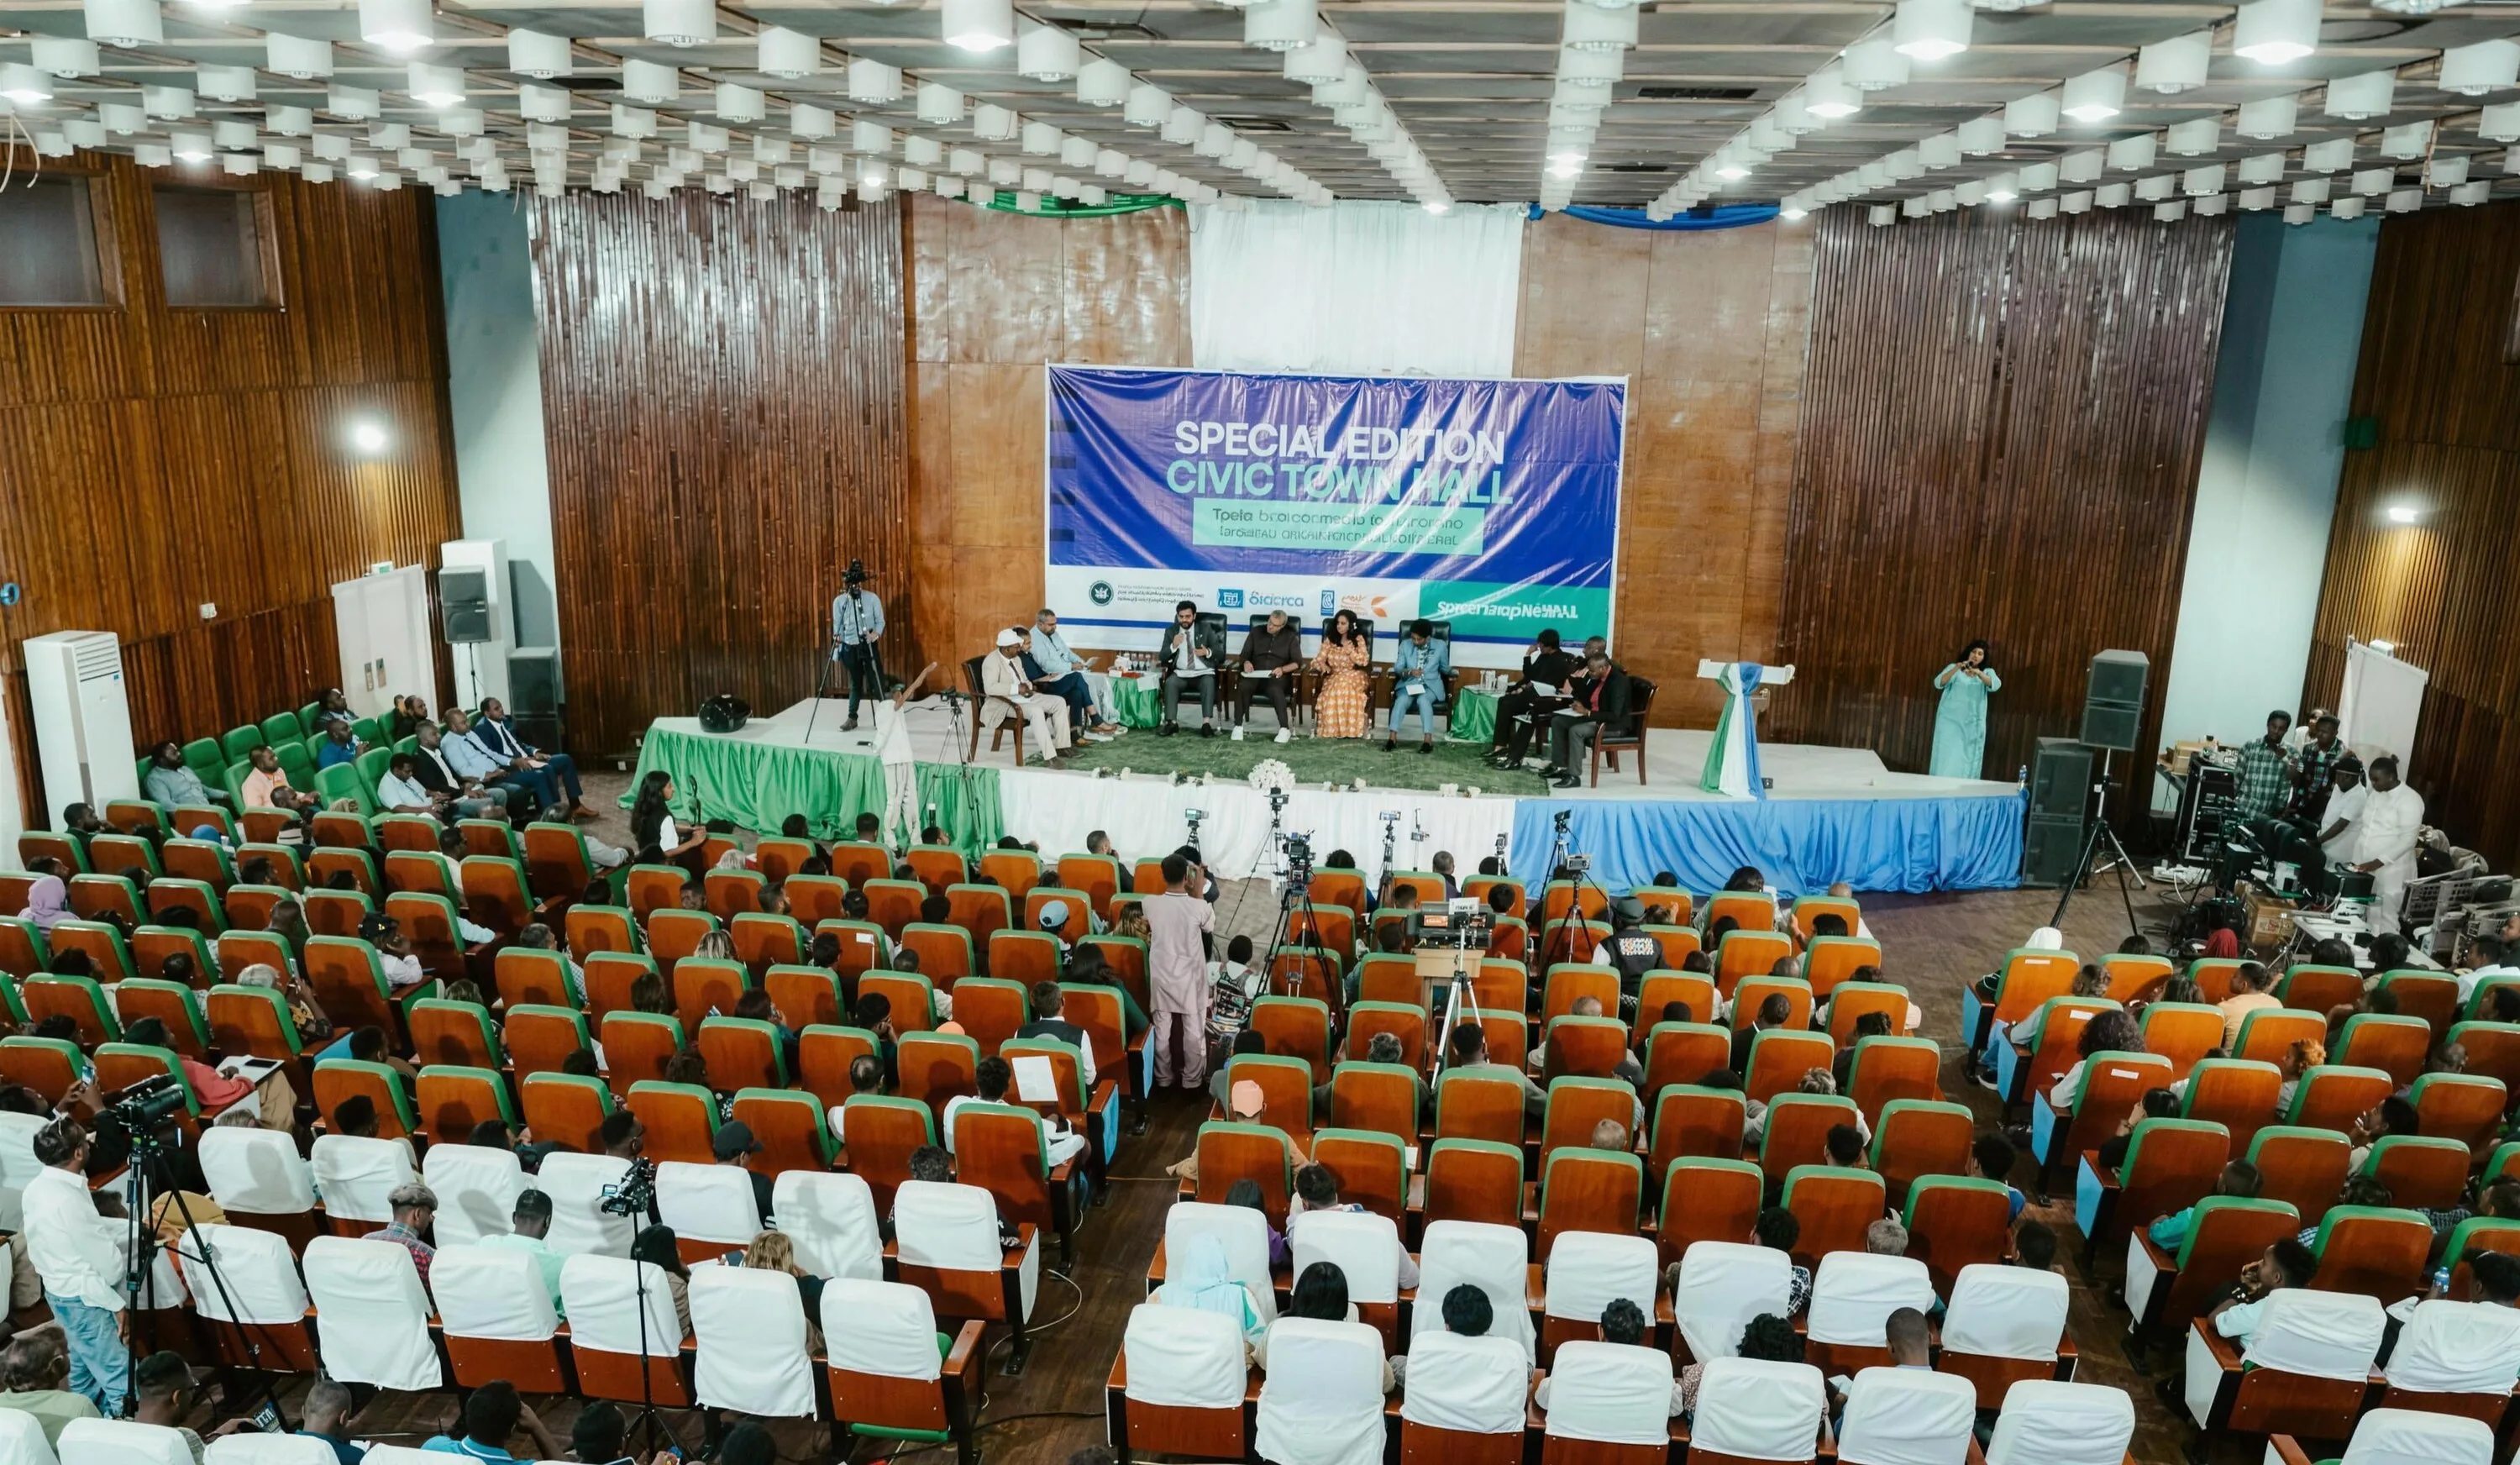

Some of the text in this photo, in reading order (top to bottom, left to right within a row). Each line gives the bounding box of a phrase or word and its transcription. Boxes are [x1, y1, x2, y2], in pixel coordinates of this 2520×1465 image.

[1174, 420, 1504, 465] SPECIAL EDITION
[1166, 459, 1513, 504] CIVIC TOWN HALL
